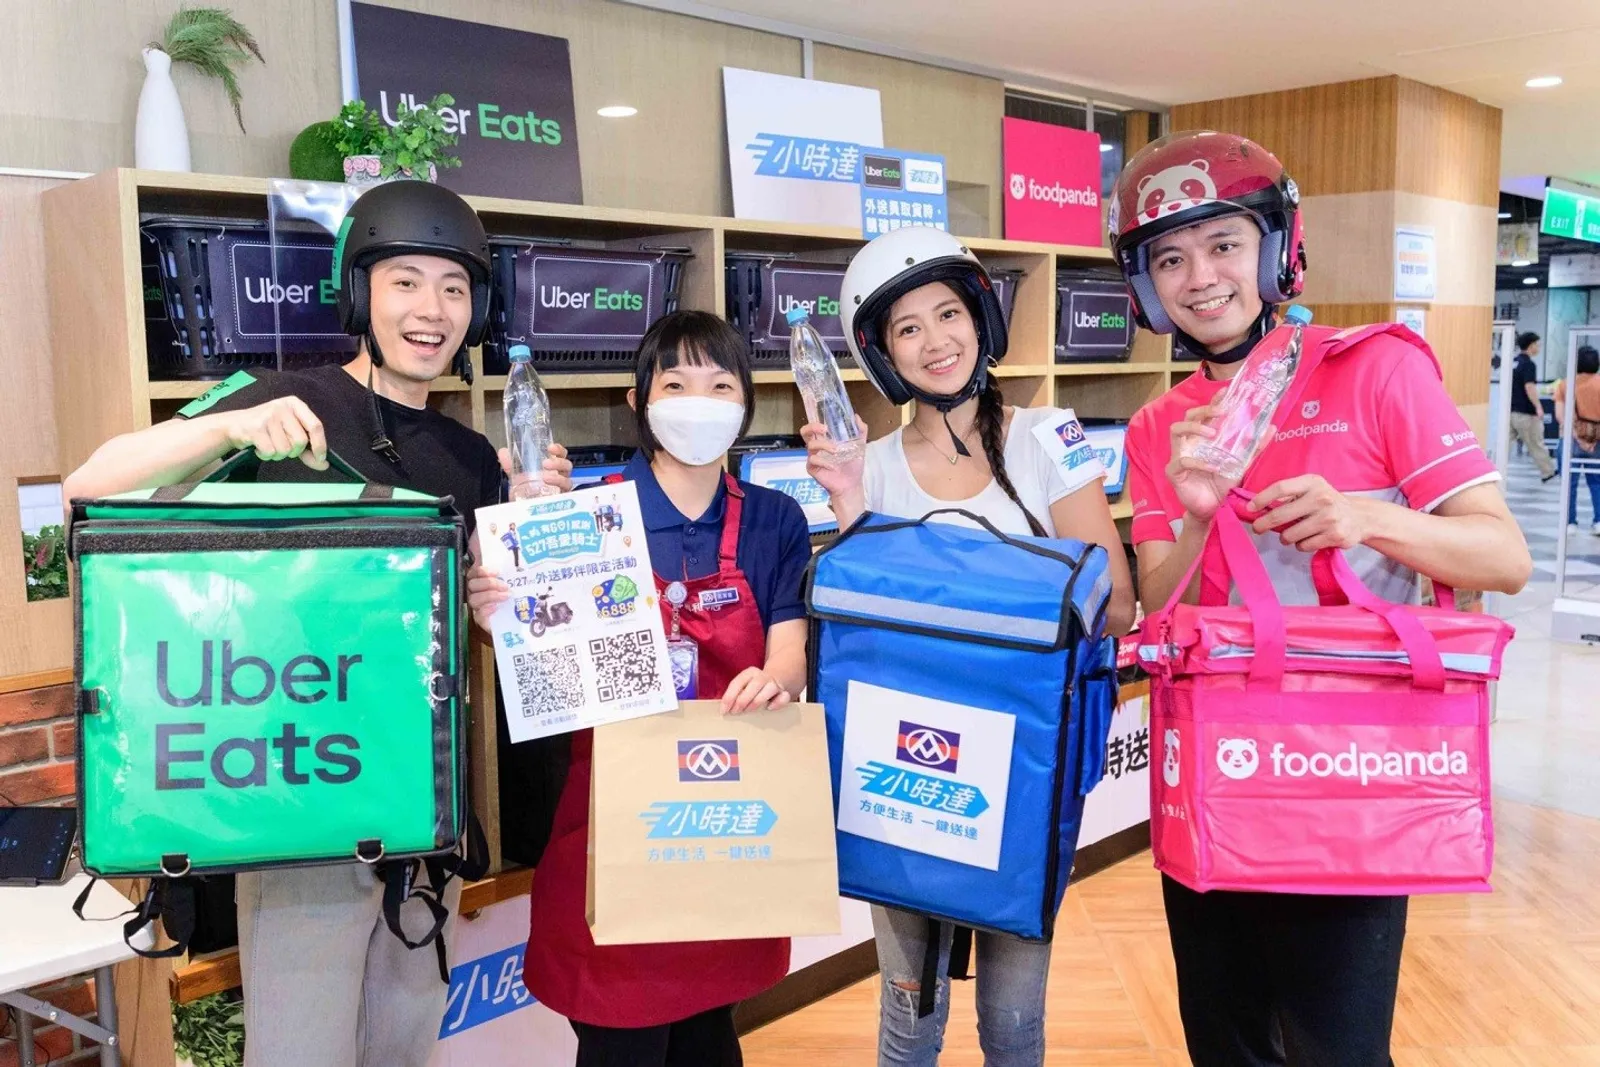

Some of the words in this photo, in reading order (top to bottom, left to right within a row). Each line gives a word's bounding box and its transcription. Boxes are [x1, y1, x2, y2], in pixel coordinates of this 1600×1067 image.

[478, 104, 562, 146] Eats
[773, 140, 859, 180] 小時達
[865, 165, 882, 176] Uber
[883, 168, 900, 178] Eats
[1029, 180, 1098, 207] foodpanda
[1551, 216, 1570, 230] EXIT
[244, 276, 313, 304] Uber
[540, 286, 590, 309] Uber
[594, 288, 643, 311] Eats
[818, 296, 840, 316] Ea
[1075, 312, 1100, 328] Uber
[1101, 313, 1126, 329] Eats
[535, 556, 638, 584] 外送夥伴限定活動
[156, 640, 363, 708] Uber
[155, 722, 362, 790] Eats
[1270, 741, 1468, 786] foodpanda
[880, 771, 977, 815] 小時達
[667, 803, 763, 836] 小時達
[860, 799, 914, 824] 方便生活
[921, 818, 979, 841] 一鍵送達
[648, 846, 706, 862] 方便生活
[715, 844, 772, 860] 一鍵送達
